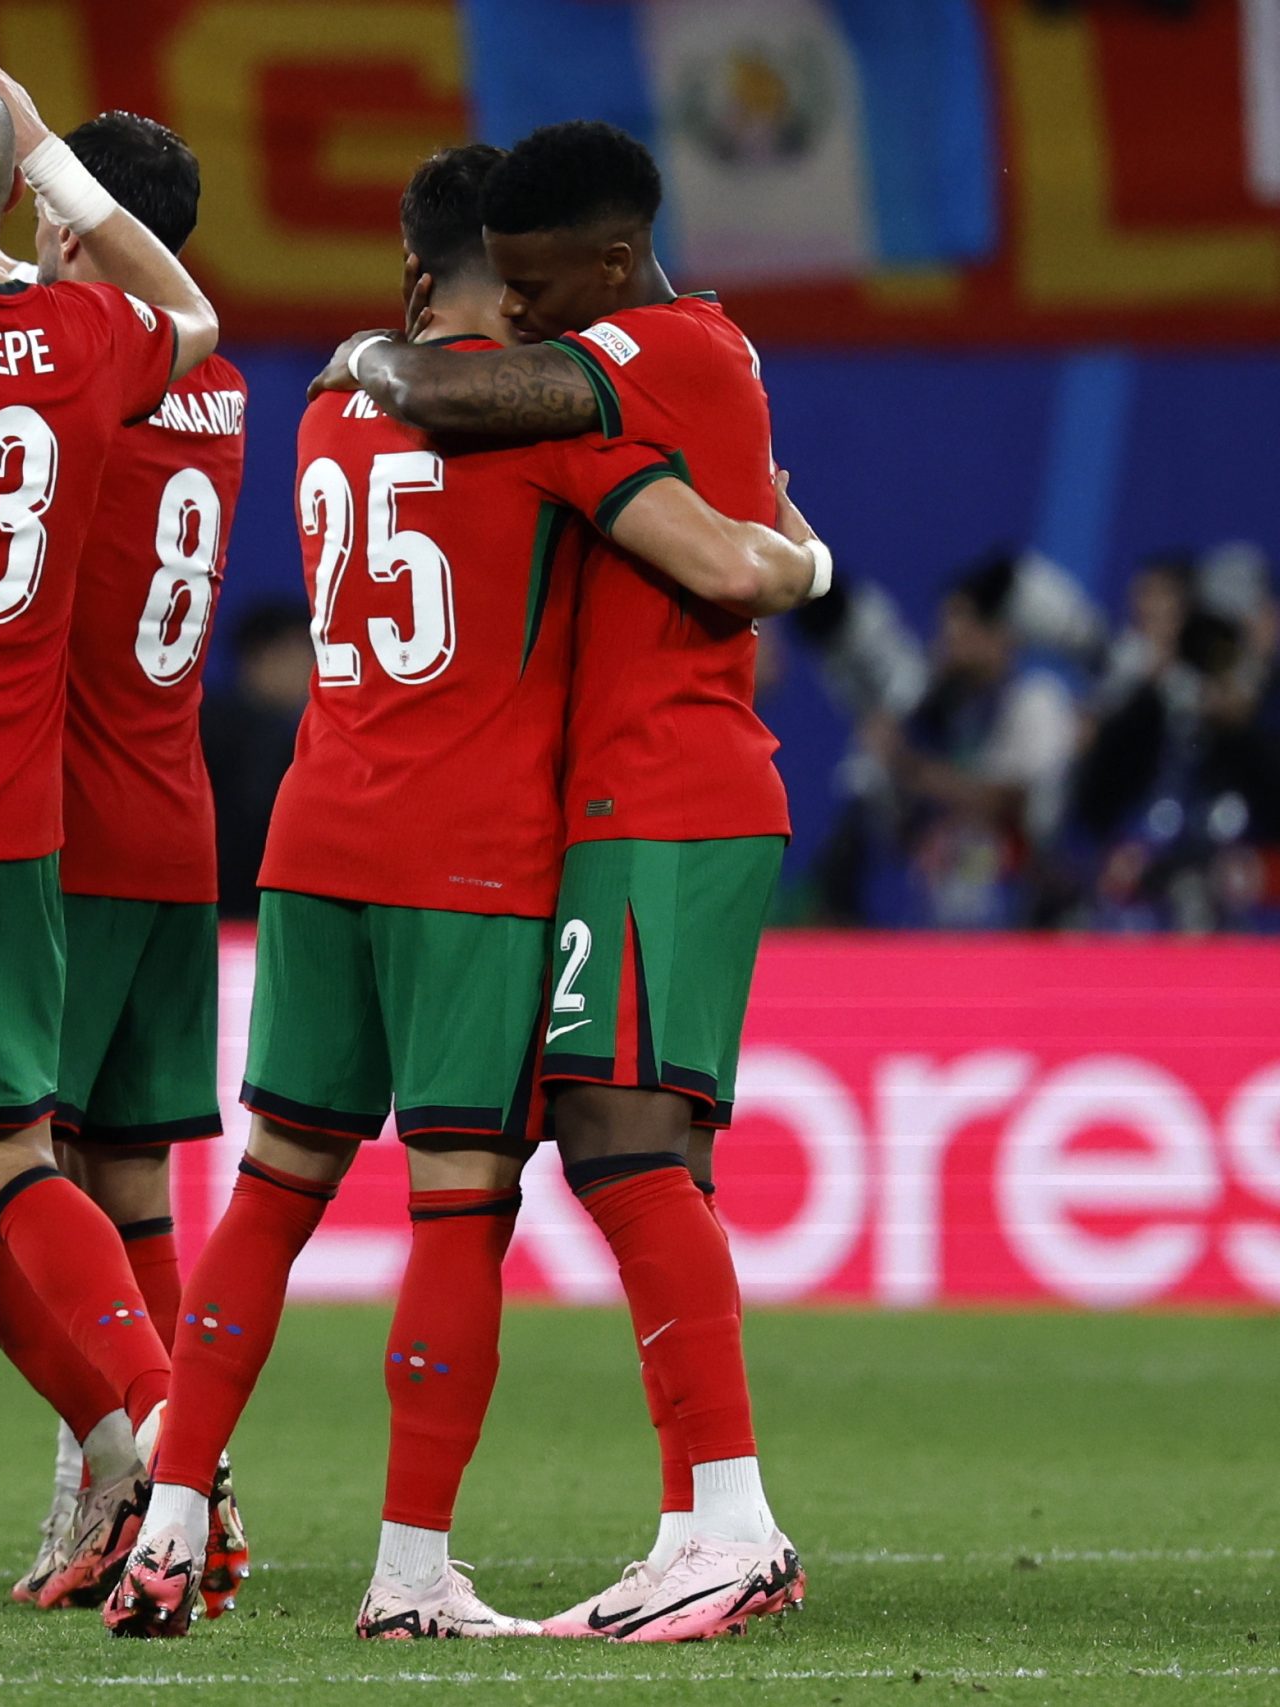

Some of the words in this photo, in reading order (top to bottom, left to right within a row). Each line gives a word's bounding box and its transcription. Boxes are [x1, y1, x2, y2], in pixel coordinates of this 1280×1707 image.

[134, 467, 221, 687] 8
[299, 450, 457, 687] 25
[553, 919, 592, 1012] 2
